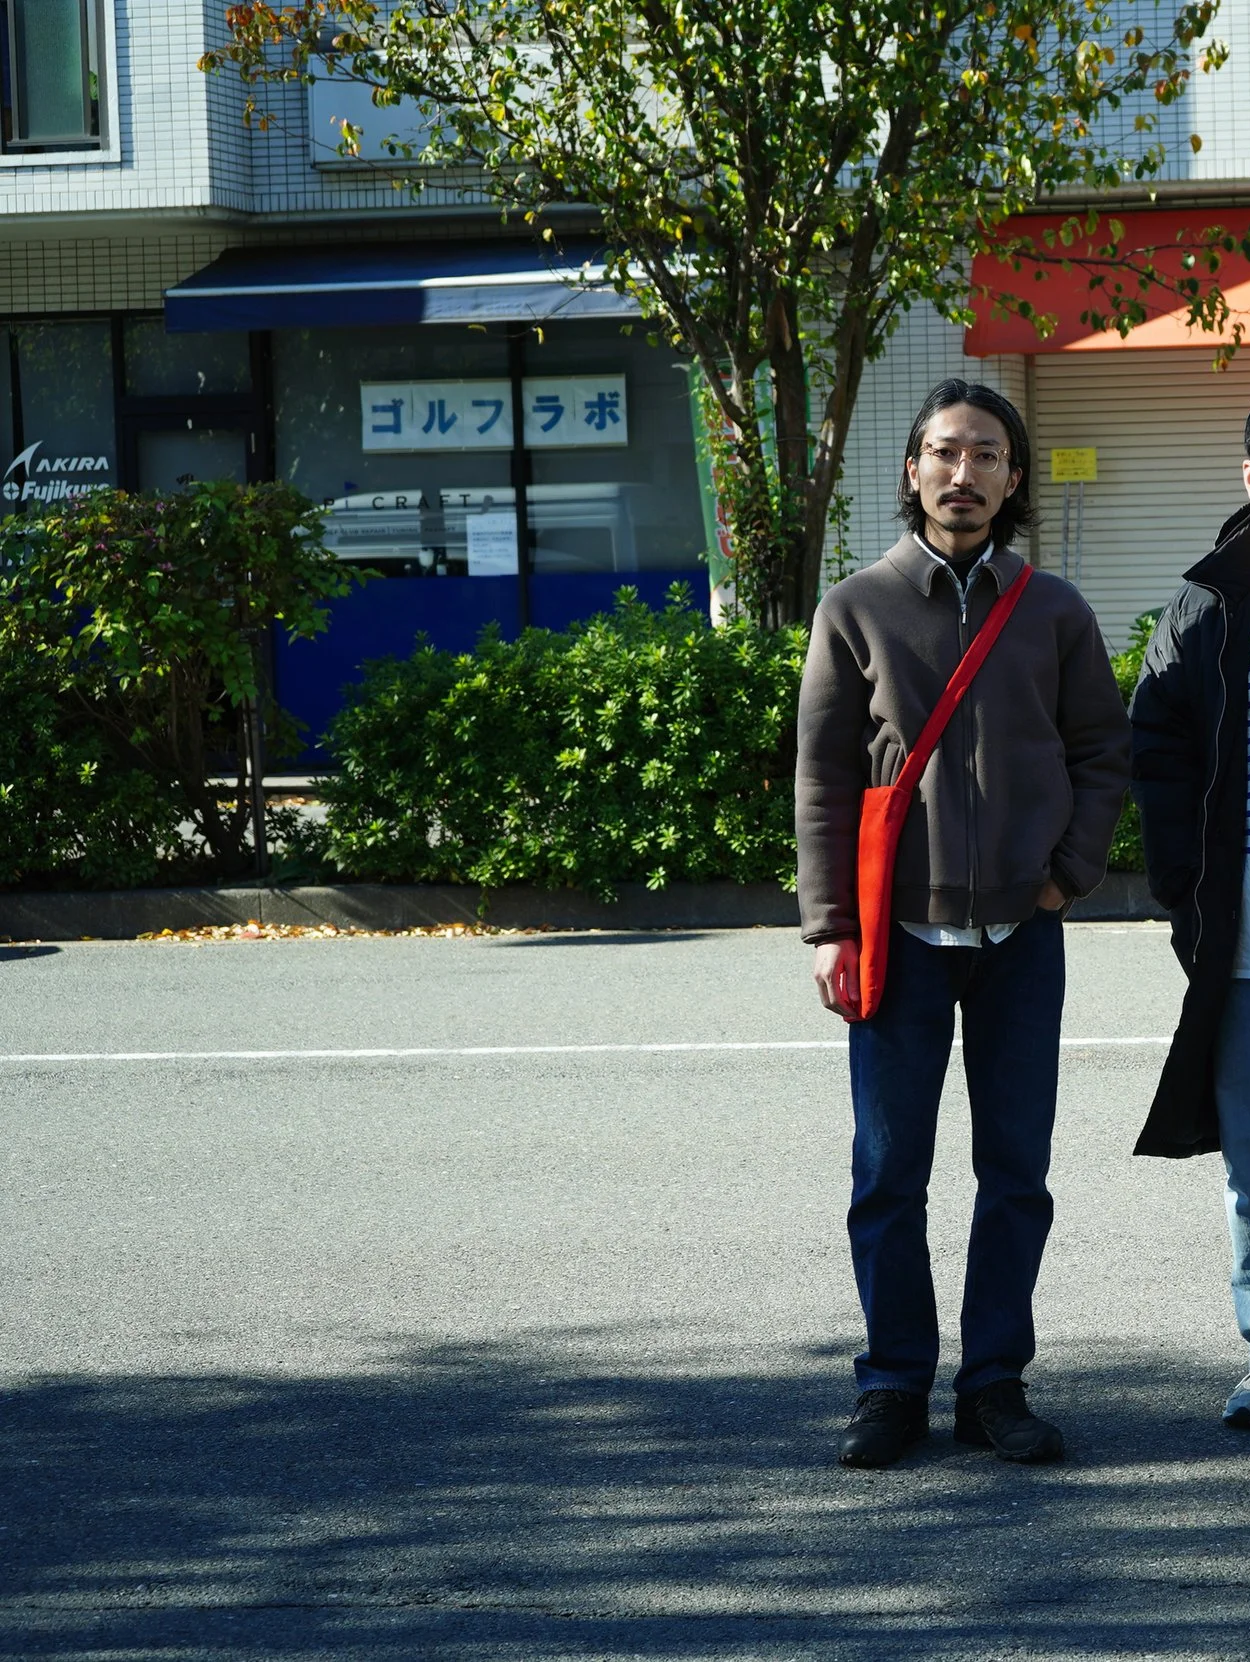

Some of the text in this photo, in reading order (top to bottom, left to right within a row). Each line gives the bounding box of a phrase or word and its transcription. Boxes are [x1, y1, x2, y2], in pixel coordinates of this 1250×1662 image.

[371, 391, 621, 435] ゴルフラボ
[36, 456, 109, 472] AKIRA
[372, 493, 471, 510] CRAFT
